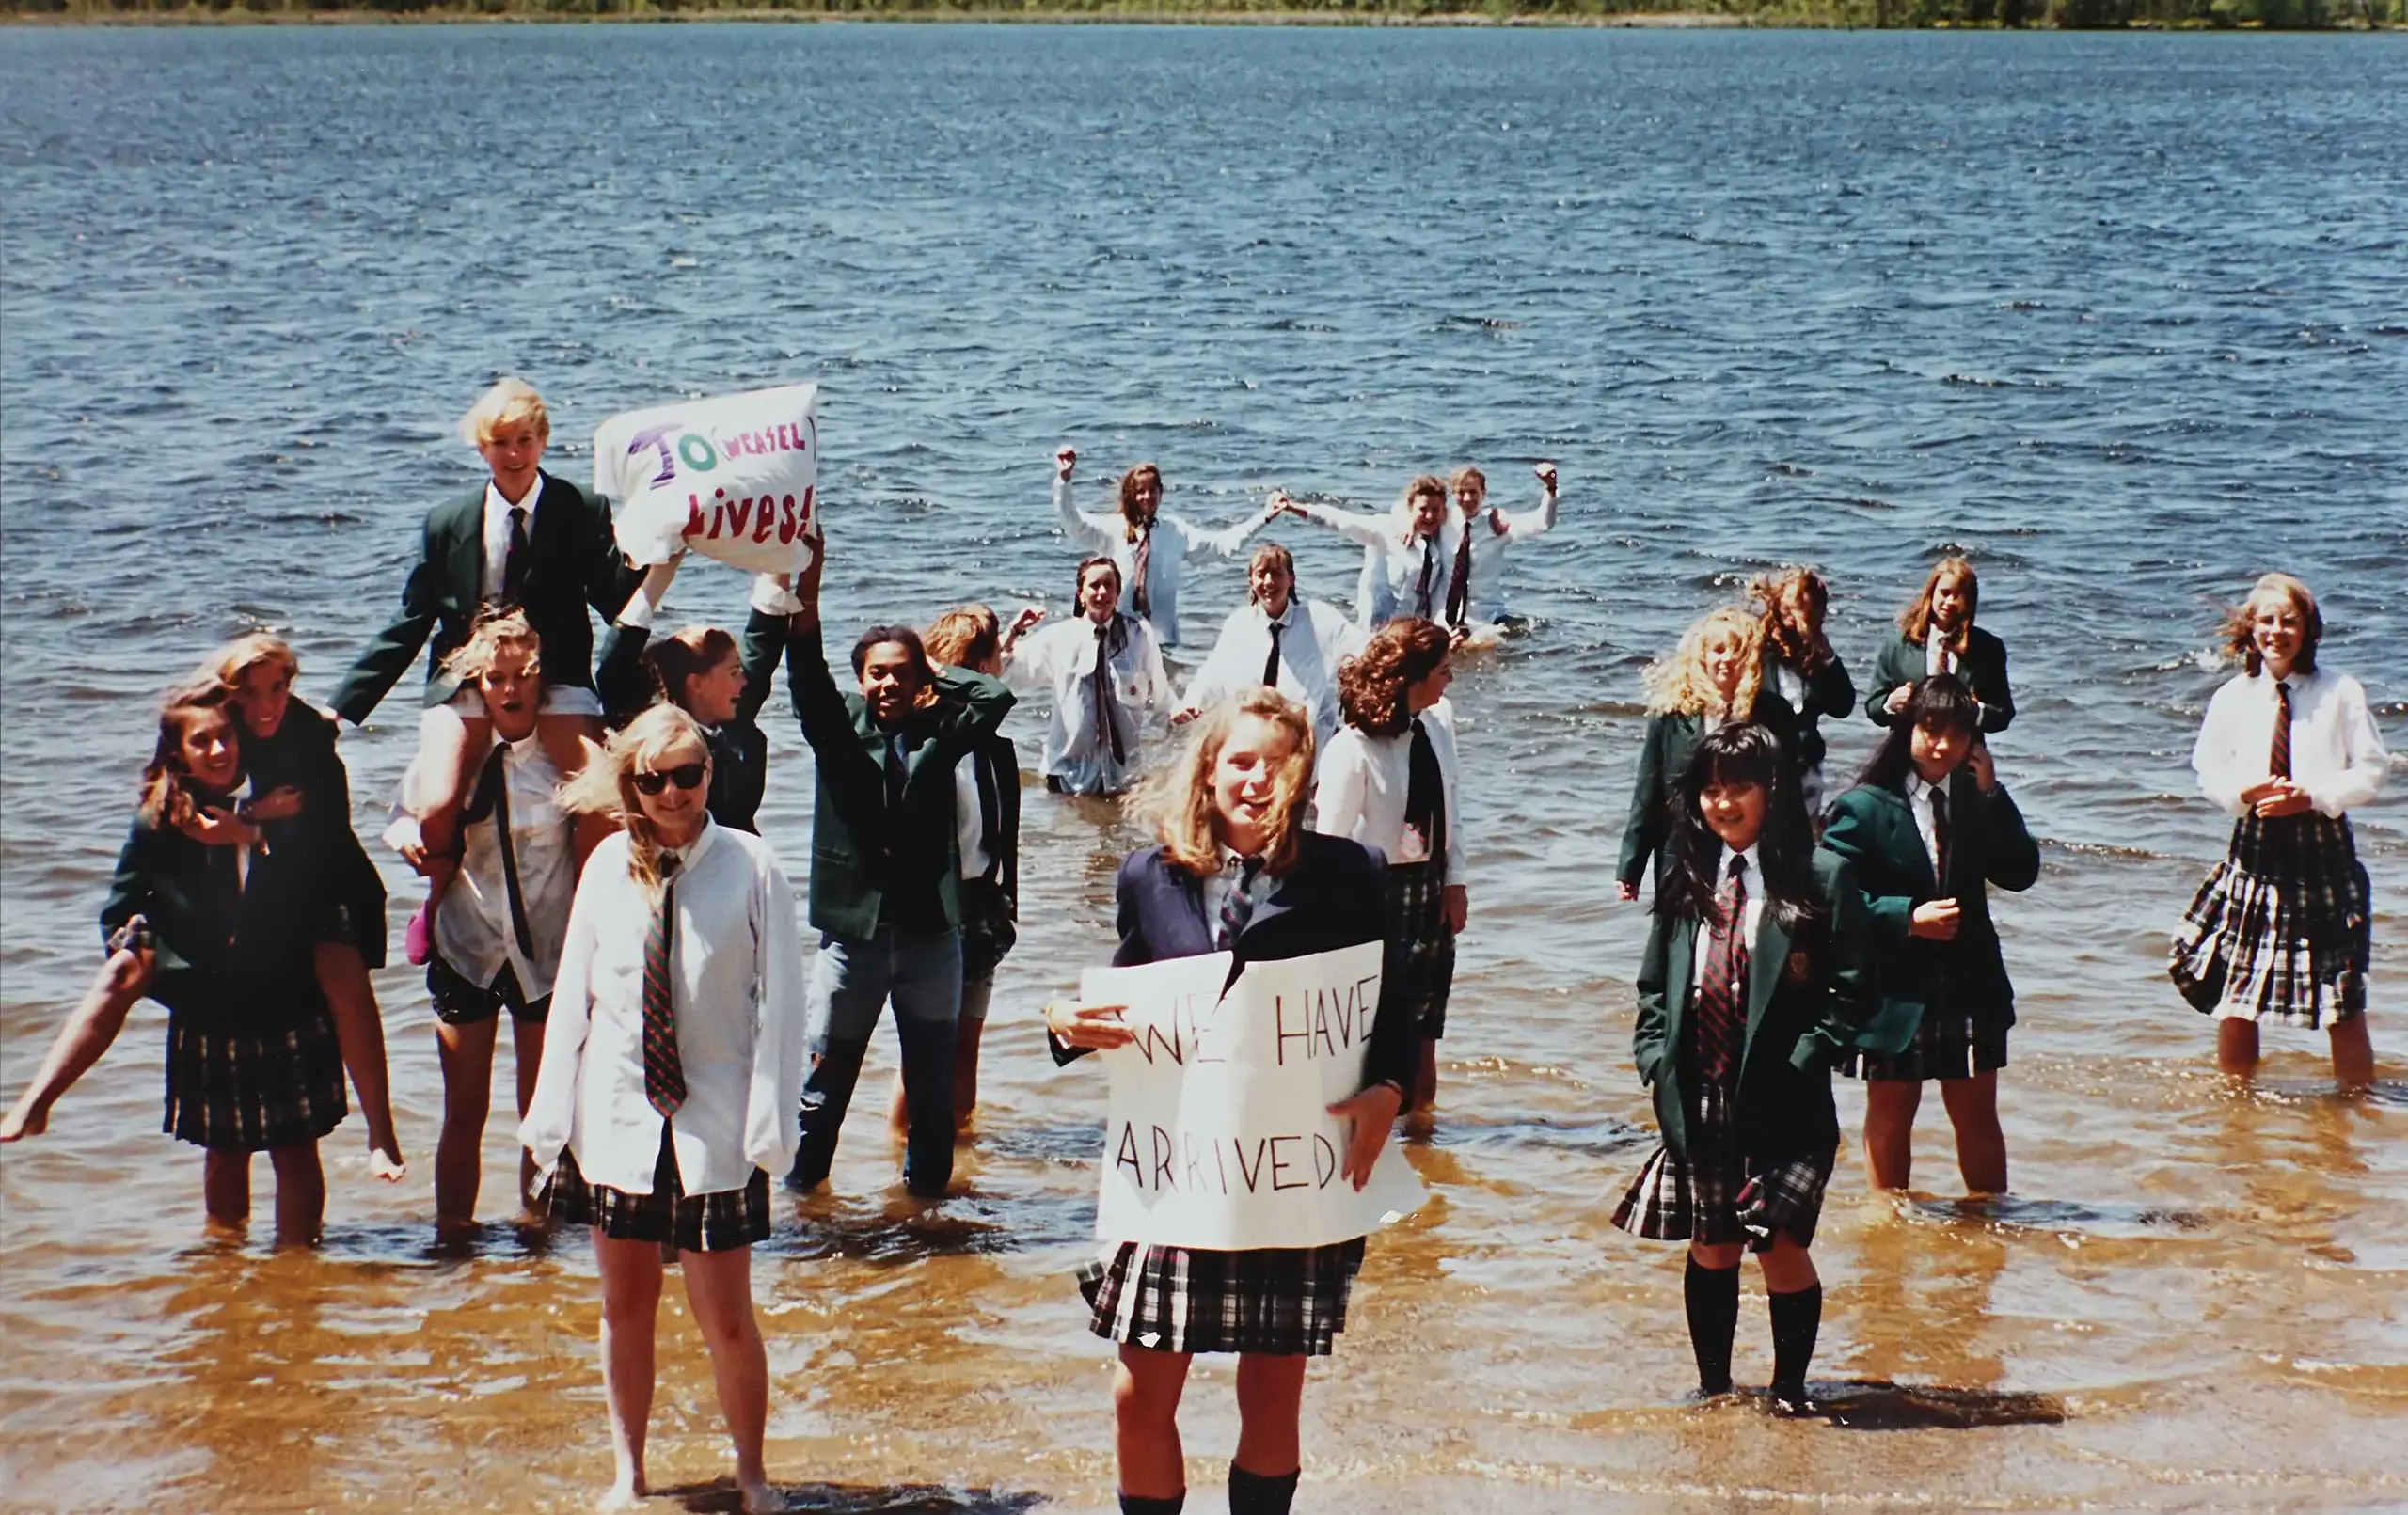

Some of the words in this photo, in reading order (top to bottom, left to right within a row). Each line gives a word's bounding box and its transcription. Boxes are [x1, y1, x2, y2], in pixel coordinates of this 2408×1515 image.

[681, 484, 814, 545] Lives!
[1115, 991, 1227, 1066] WE
[1275, 974, 1378, 1066] HAVE
[1117, 1120, 1336, 1195] ARRIVED
